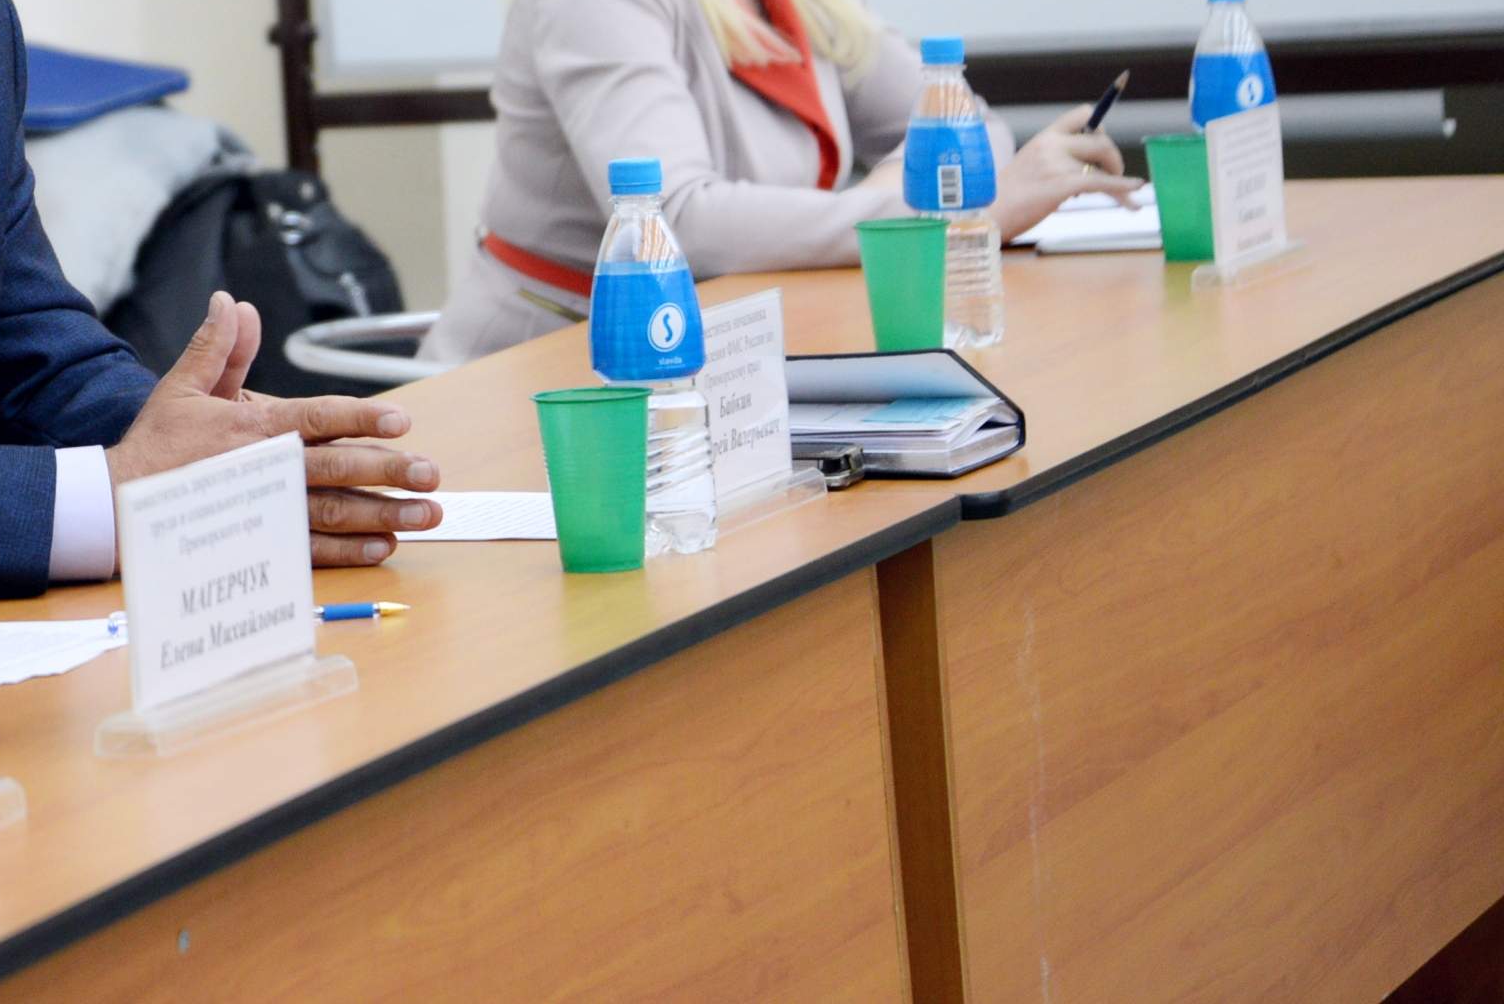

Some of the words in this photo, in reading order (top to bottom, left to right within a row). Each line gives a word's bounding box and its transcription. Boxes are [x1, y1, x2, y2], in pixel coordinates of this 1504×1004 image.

[181, 560, 271, 616] МАГЕРЧУК
[161, 636, 205, 670] Елена
[210, 602, 296, 648] Михайловна
